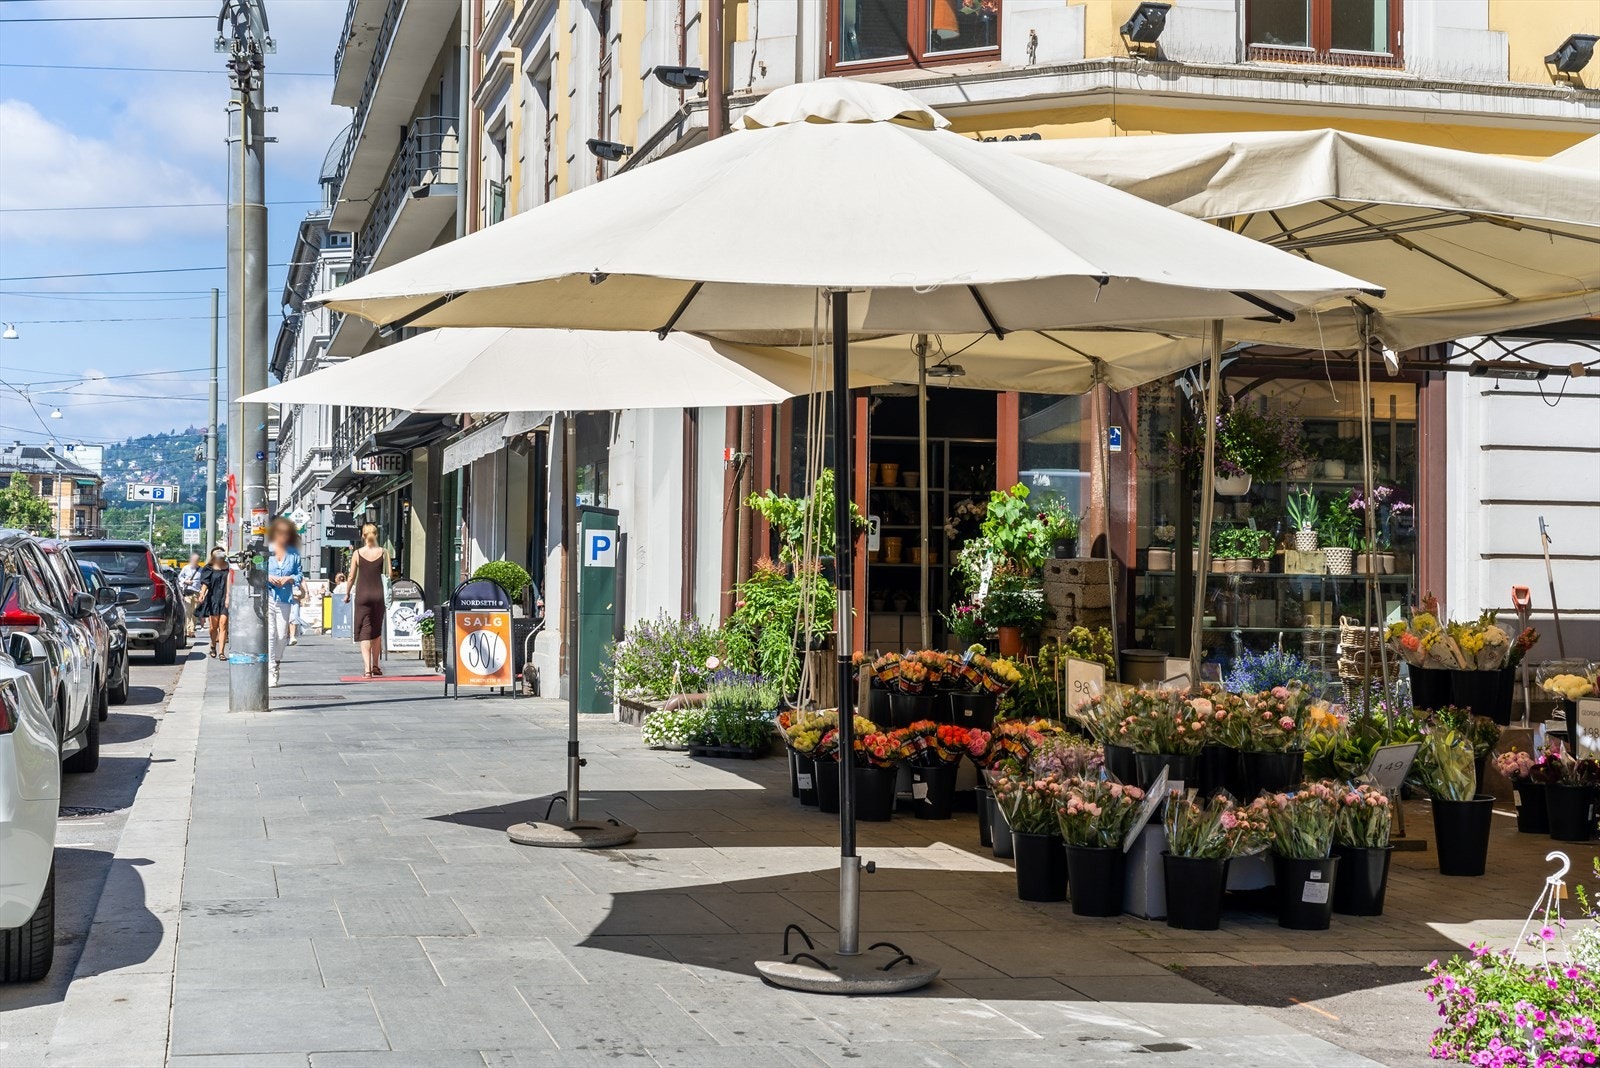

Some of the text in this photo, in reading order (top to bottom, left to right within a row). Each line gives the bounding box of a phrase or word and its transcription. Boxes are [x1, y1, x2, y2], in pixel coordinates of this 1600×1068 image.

[187, 516, 196, 528] P
[592, 535, 611, 561] P
[463, 617, 503, 627] SALG
[1583, 727, 1600, 739] 198
[1377, 760, 1404, 772] 149
